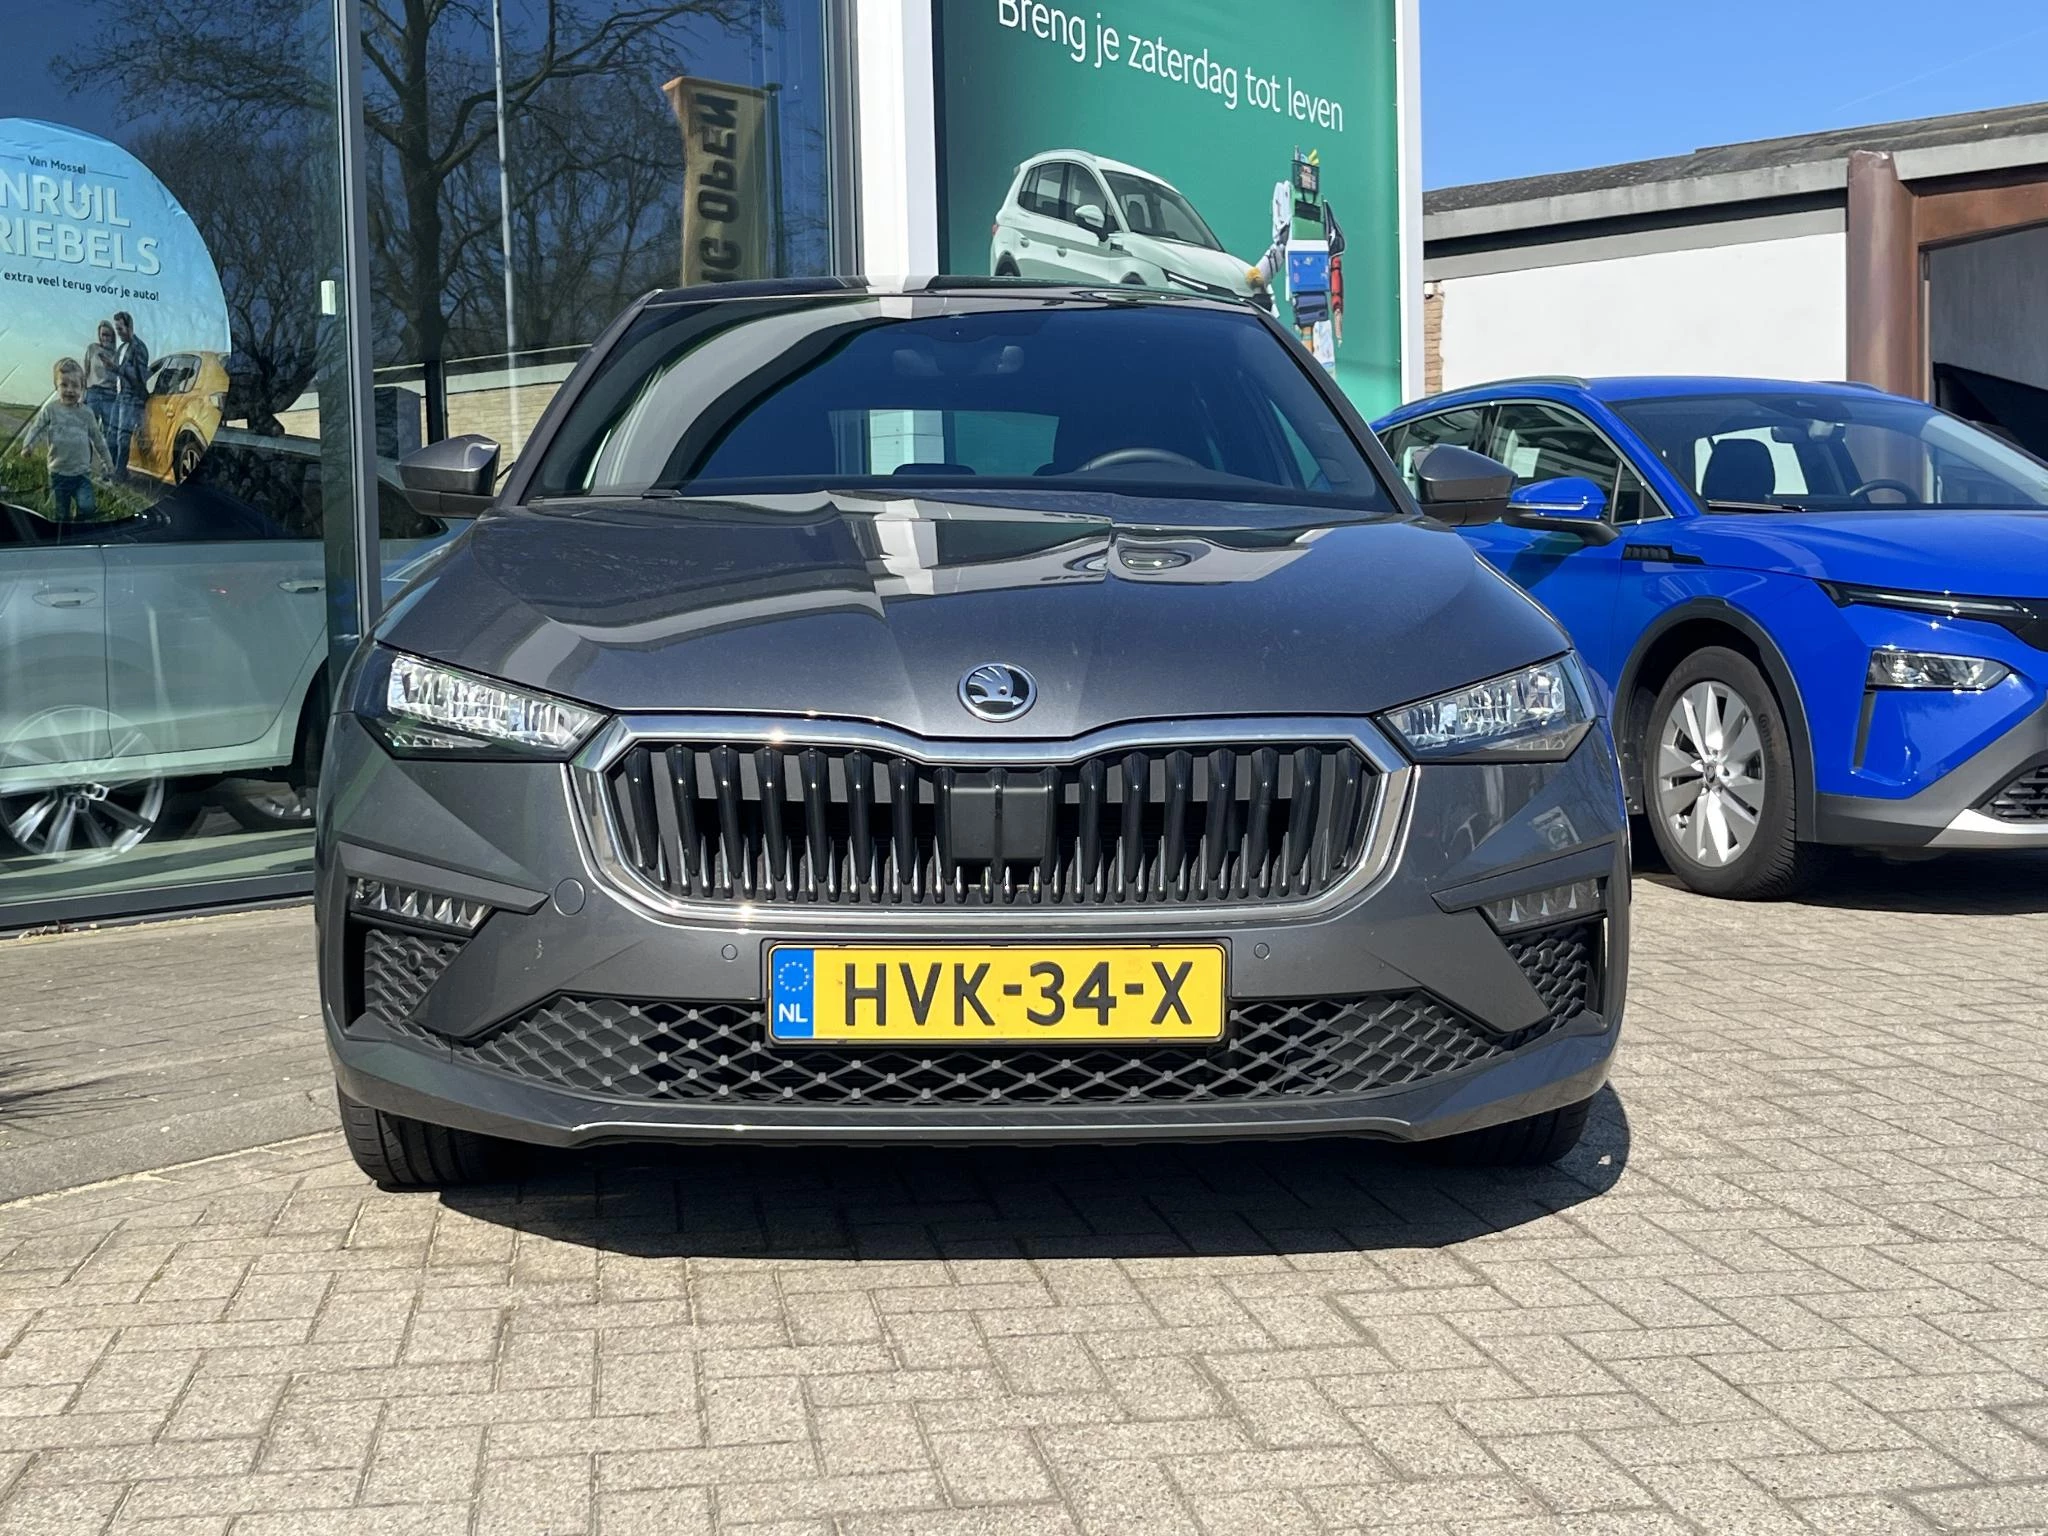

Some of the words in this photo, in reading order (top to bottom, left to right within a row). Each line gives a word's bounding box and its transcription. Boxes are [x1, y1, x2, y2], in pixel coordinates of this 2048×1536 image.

[999, 0, 1087, 62] Breng
[1094, 12, 1120, 68] je
[1127, 34, 1238, 110] zaterdag
[1244, 66, 1281, 114] tot
[1287, 76, 1343, 131] leven
[28, 155, 49, 167] Van
[51, 159, 87, 174] Mossel
[4, 271, 34, 284] extra
[36, 276, 60, 287] veel
[62, 278, 92, 293] terug
[95, 284, 119, 296] voor
[120, 285, 131, 298] je
[133, 289, 160, 302] auto!
[844, 960, 1194, 1027] HVK-34-X
[778, 1002, 809, 1024] NL
